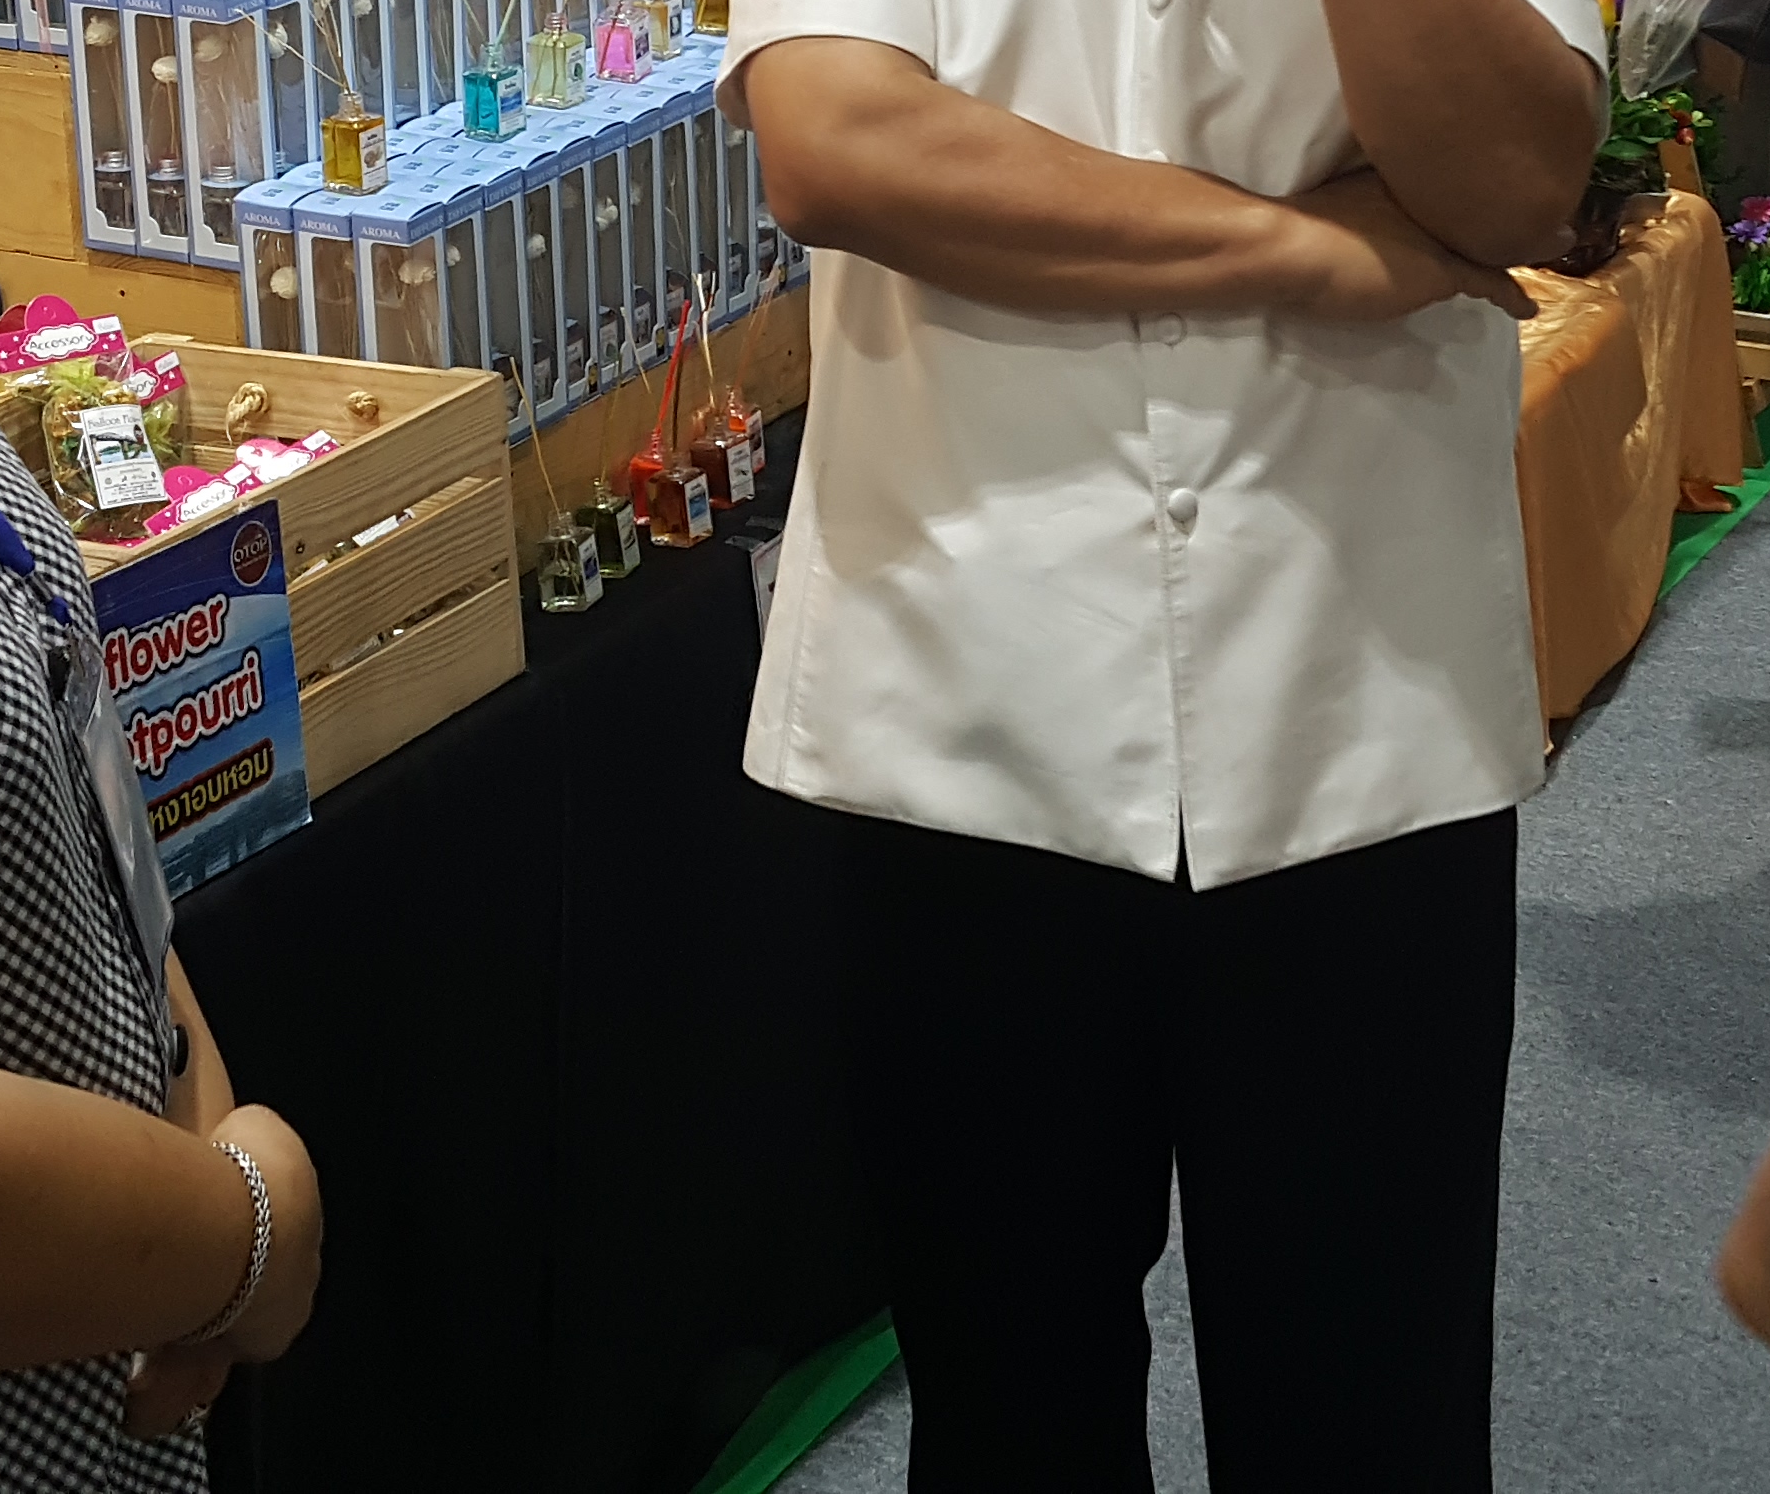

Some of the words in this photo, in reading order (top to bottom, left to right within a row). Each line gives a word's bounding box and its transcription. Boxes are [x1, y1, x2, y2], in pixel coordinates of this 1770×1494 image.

[180, 4, 218, 18] AROMA
[243, 212, 281, 226] AROMA
[300, 219, 339, 234] AROMA
[360, 226, 401, 240] AROMA
[29, 333, 94, 352] Accessory
[233, 535, 268, 564] OTOP
[102, 598, 225, 692] flower
[127, 656, 261, 773] tpourri
